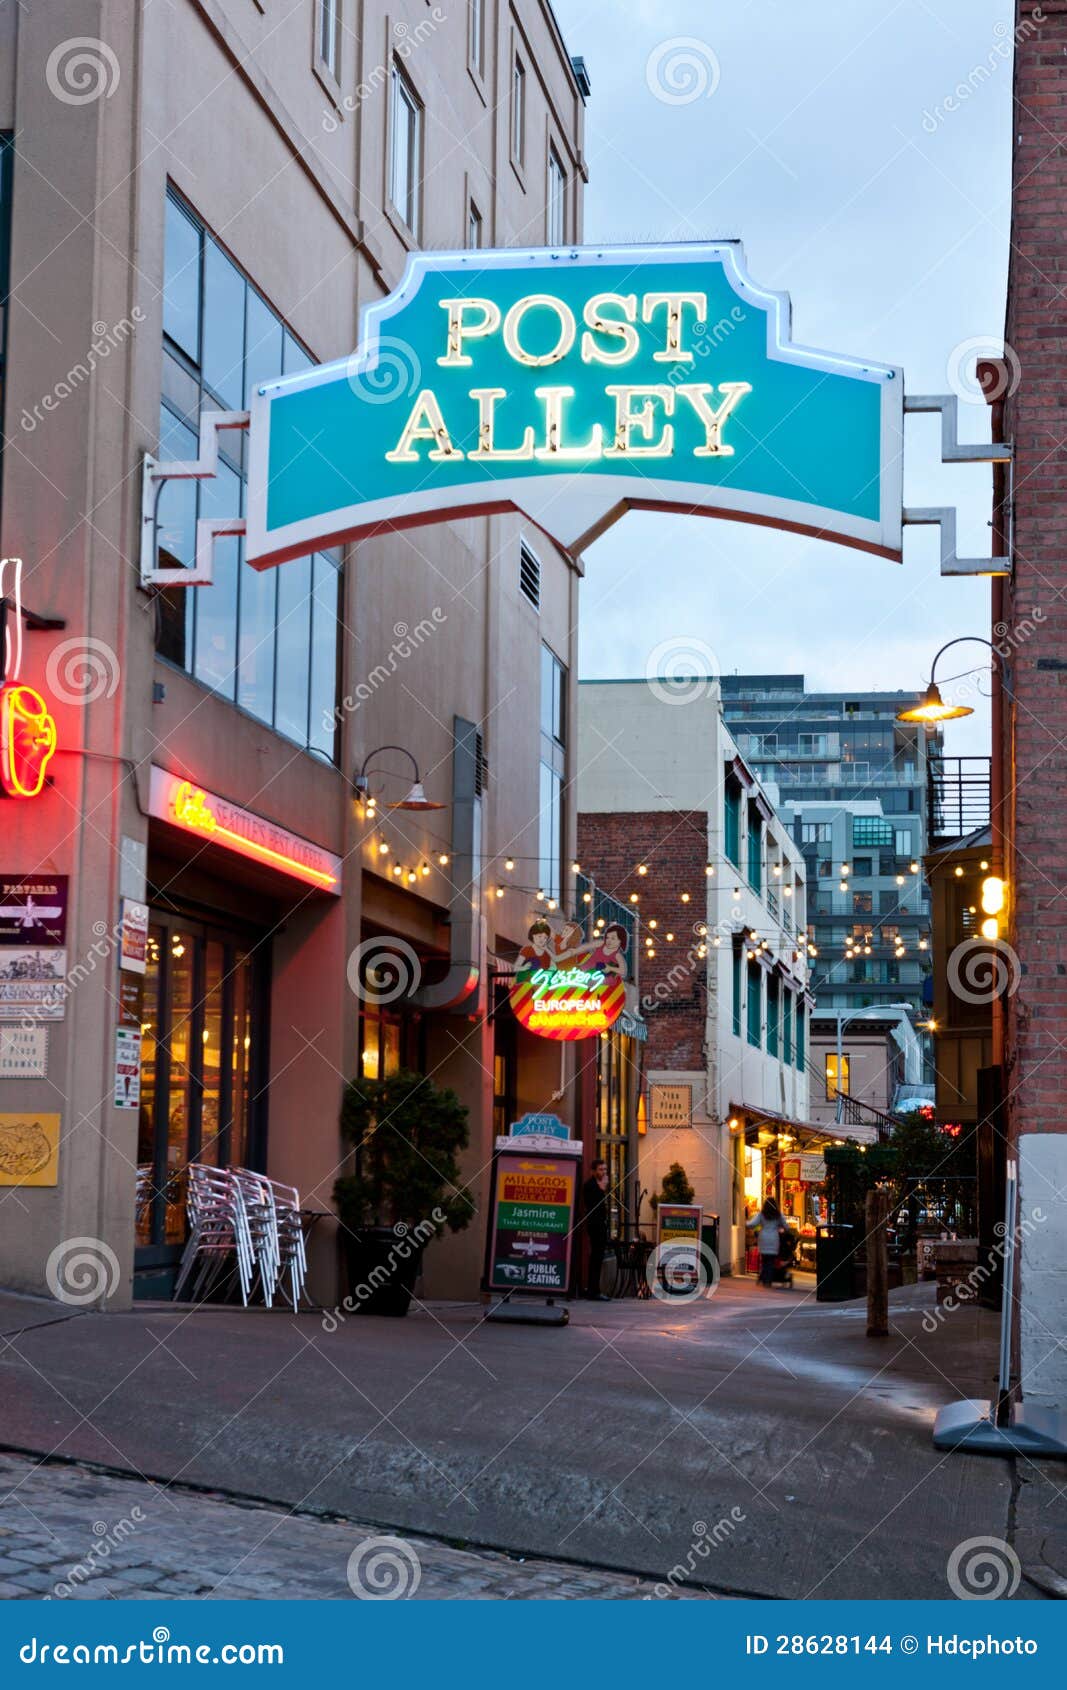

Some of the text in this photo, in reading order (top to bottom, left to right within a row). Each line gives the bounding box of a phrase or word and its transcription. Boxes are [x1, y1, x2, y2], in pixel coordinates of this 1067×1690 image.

[437, 292, 707, 367] POST
[385, 382, 752, 461] ALLEY
[530, 967, 605, 999] Sisters
[534, 1000, 601, 1011] EUROPEAN
[528, 1116, 554, 1125] POST
[525, 1125, 557, 1134] ALLEY
[504, 1175, 568, 1187] MILAGROS
[512, 1207, 557, 1219] Jasmine
[528, 1263, 557, 1275] PUBLIC
[527, 1274, 560, 1286] SEATING
